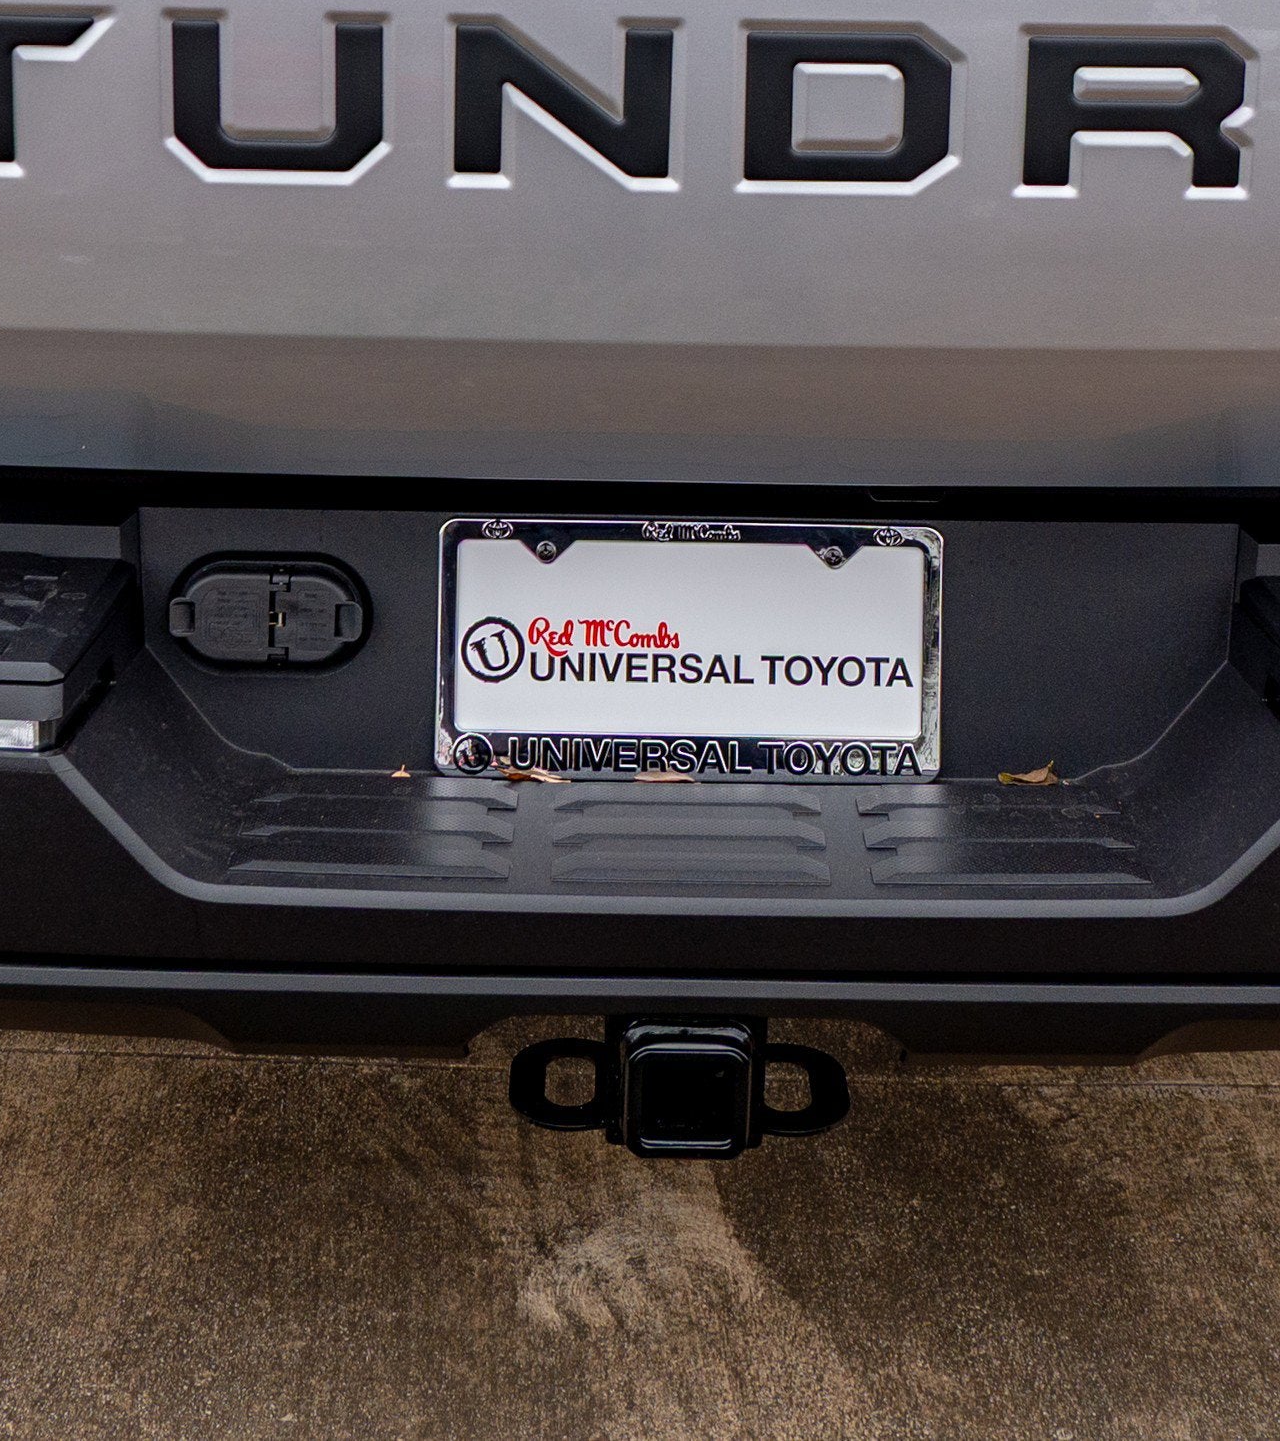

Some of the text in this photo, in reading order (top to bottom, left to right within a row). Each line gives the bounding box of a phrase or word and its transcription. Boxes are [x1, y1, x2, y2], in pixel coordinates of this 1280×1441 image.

[528, 617, 680, 657] Red McCombs
[530, 651, 914, 688] UNIVERSAL TOYOTA
[507, 736, 923, 776] UNIVERSAL TOYOTA
